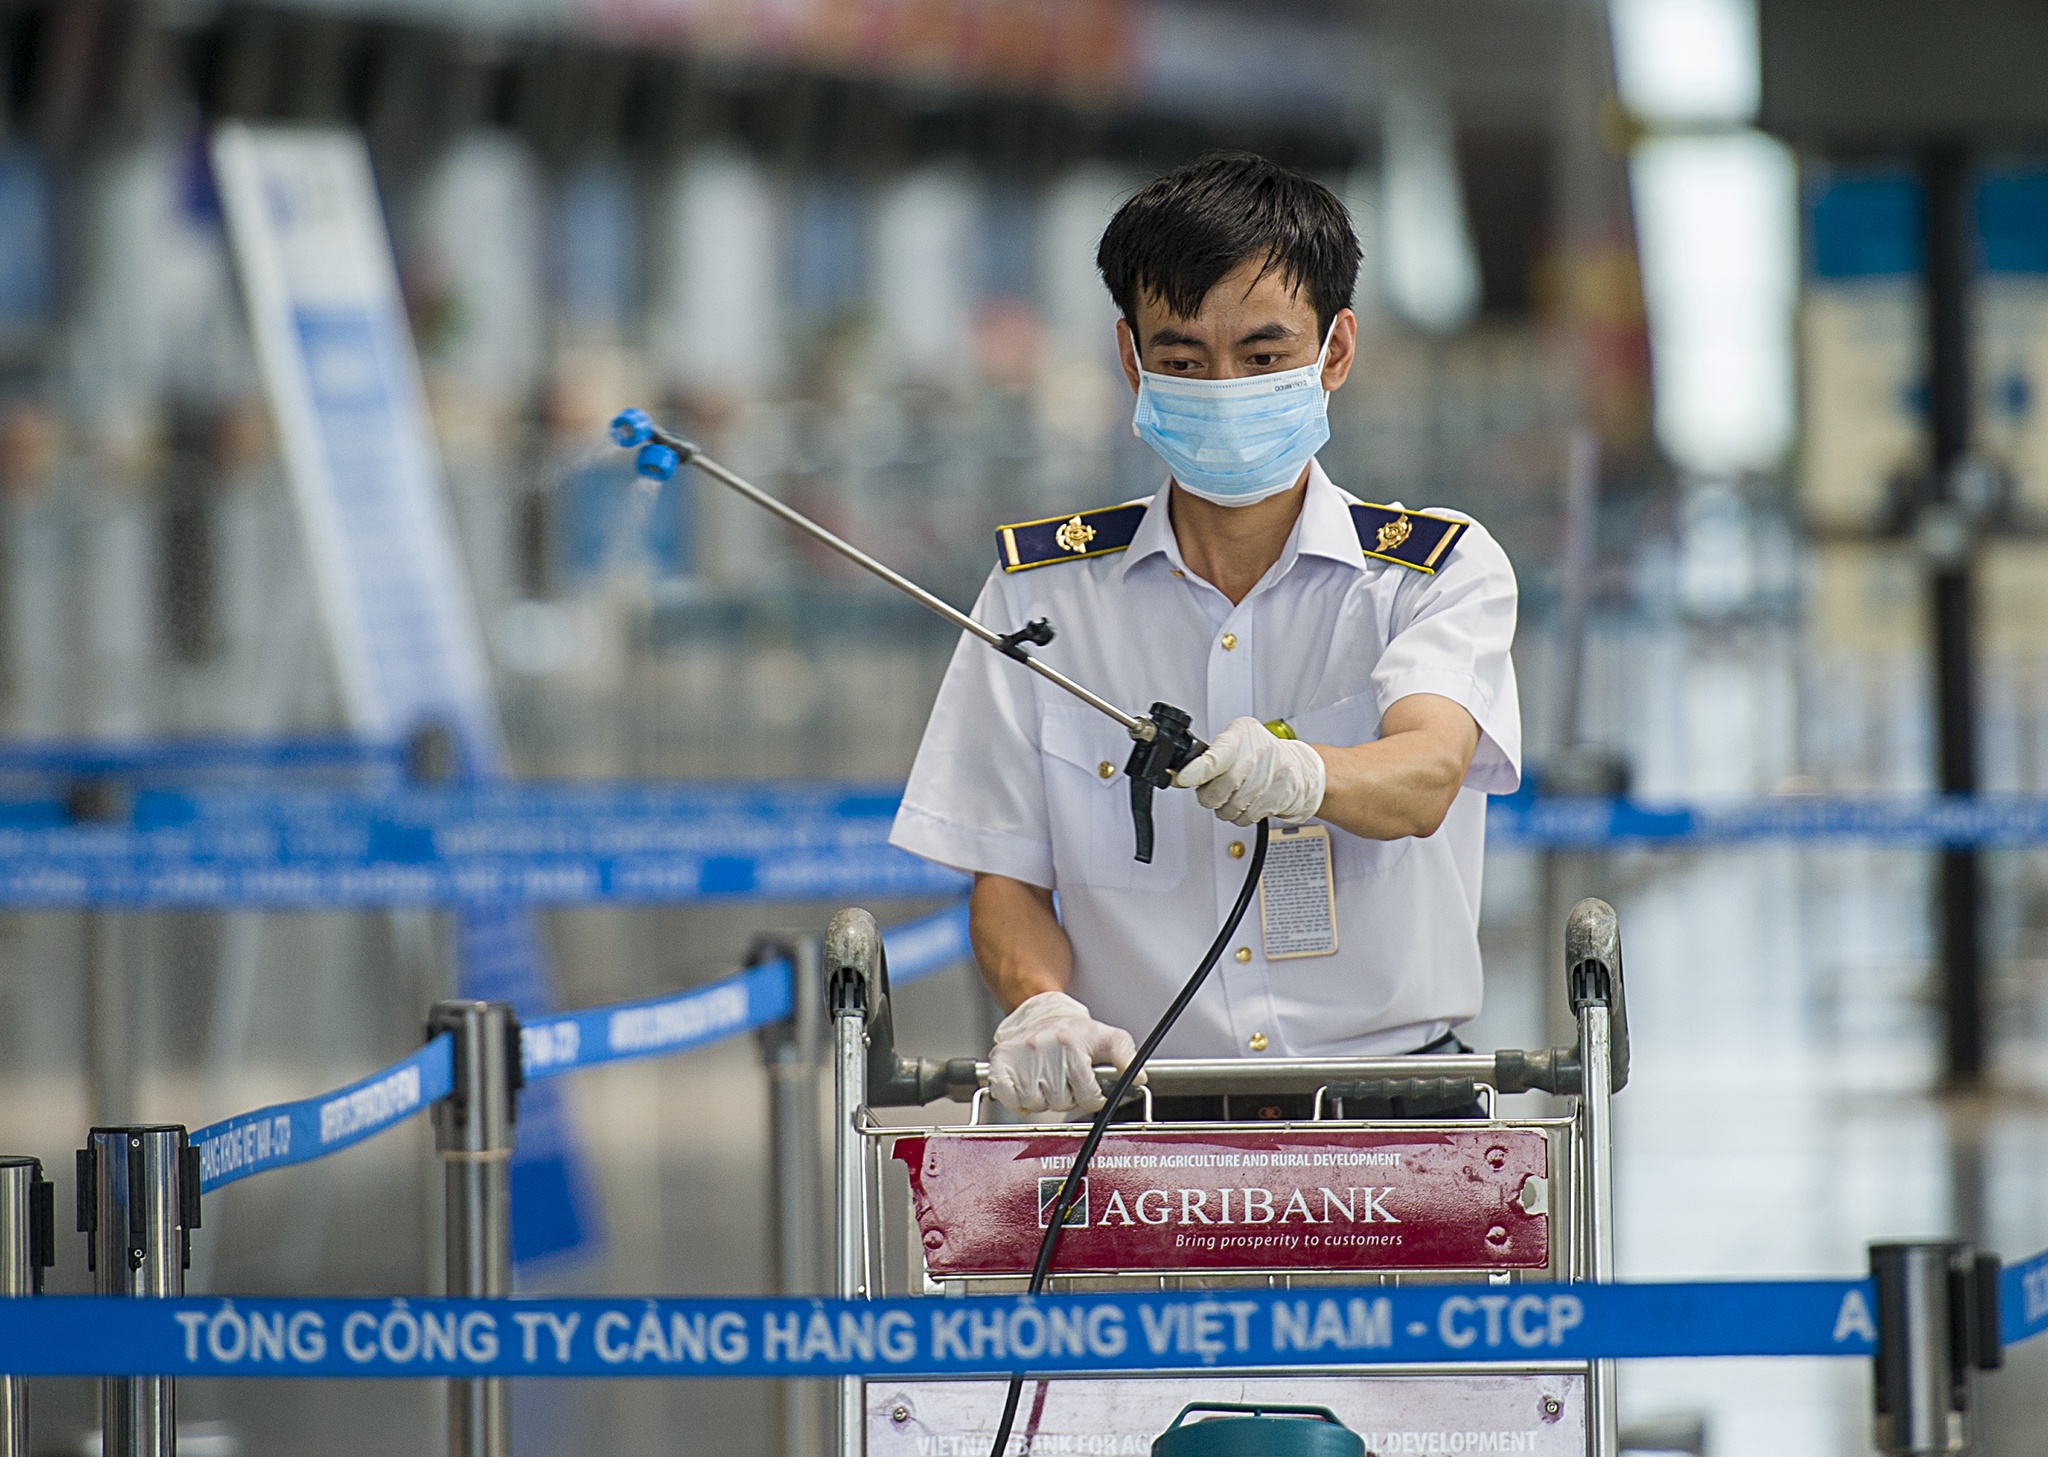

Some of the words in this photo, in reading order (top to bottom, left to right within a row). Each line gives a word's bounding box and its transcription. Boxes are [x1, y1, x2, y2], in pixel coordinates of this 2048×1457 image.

[1040, 1156, 1095, 1169] VIETNM
[1098, 1155, 1131, 1168] BANK
[1134, 1155, 1157, 1168] FOR
[1159, 1154, 1240, 1168] AGRICULTURE
[1243, 1154, 1268, 1167] AND
[1271, 1153, 1310, 1167] RURAL
[1314, 1153, 1401, 1166] DEVELOPMENT
[1097, 1187, 1402, 1226] AGRIBANK
[1175, 1234, 1215, 1250] Bring
[1220, 1234, 1300, 1249] prosperity
[1305, 1235, 1320, 1247] to
[1324, 1235, 1403, 1246] customers
[512, 1311, 581, 1363] TY
[930, 1295, 1128, 1361] KHÔNG
[1138, 1292, 1260, 1365] VIỆT
[1271, 1296, 1393, 1351] NAM
[1437, 1294, 1584, 1349] CTCP
[916, 1435, 1008, 1456] VIETNA
[1077, 1434, 1117, 1455] FOR
[1387, 1430, 1538, 1453] DEVELOPMENT
